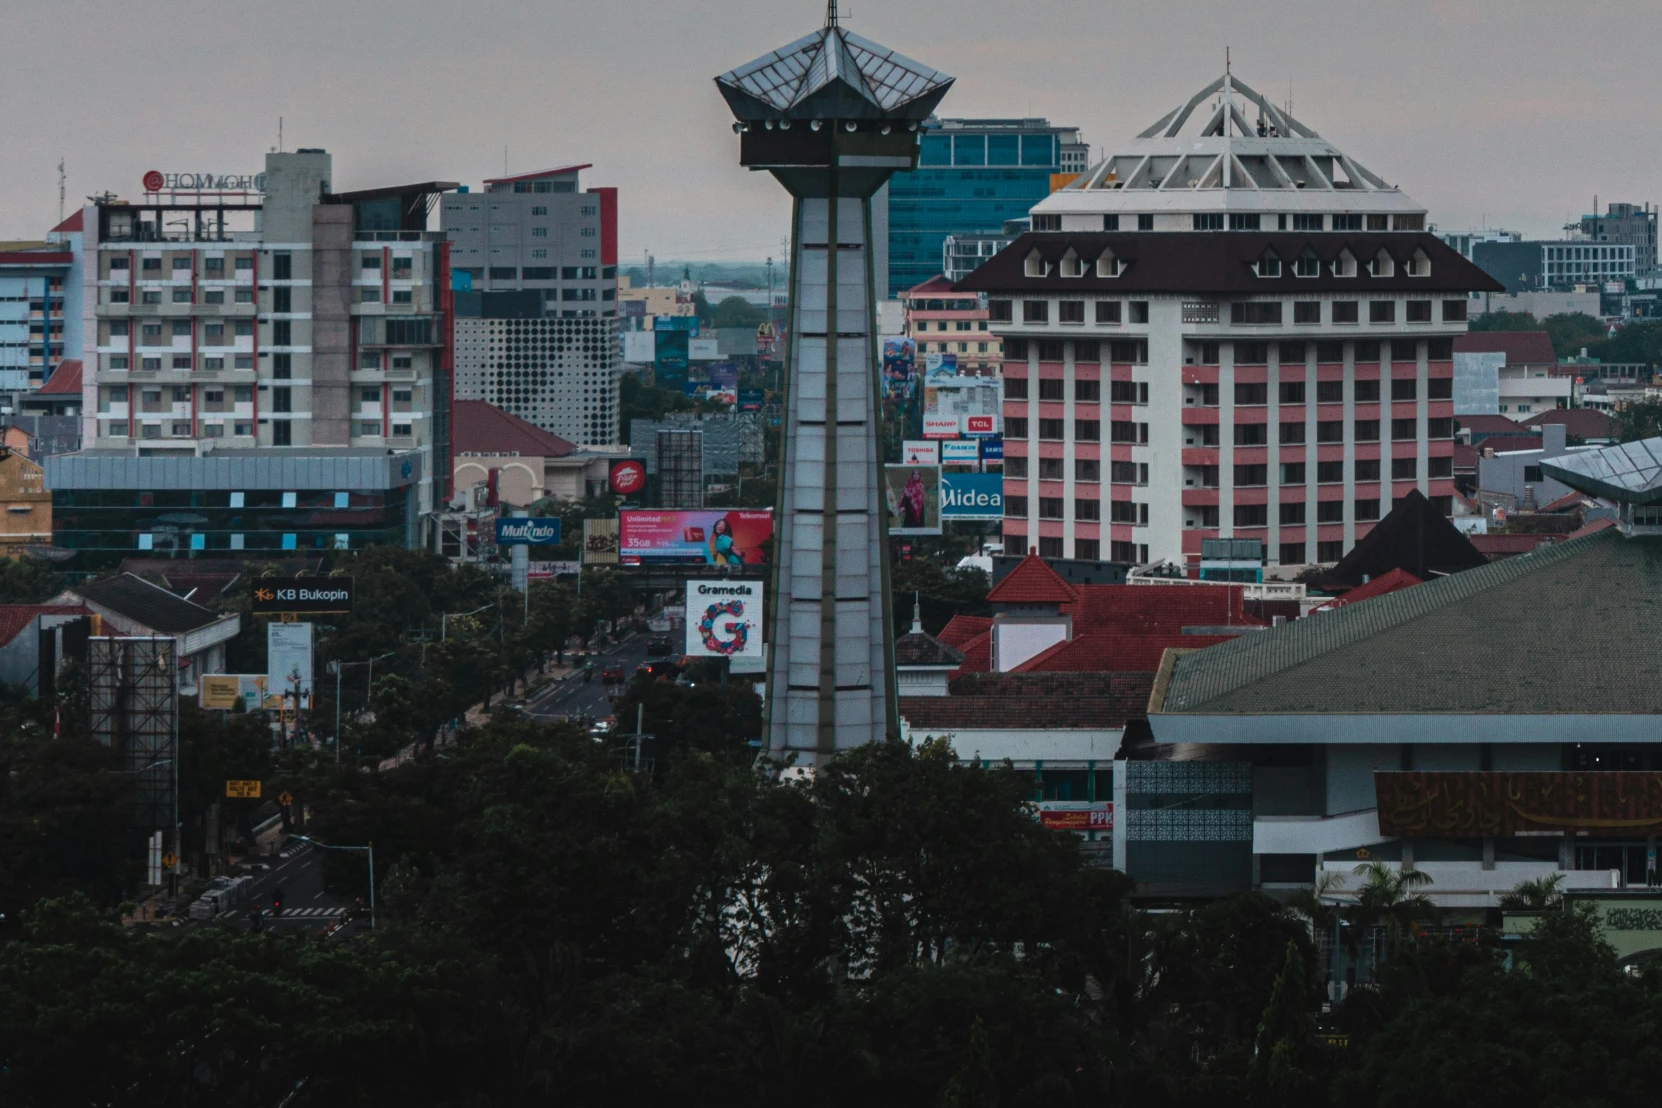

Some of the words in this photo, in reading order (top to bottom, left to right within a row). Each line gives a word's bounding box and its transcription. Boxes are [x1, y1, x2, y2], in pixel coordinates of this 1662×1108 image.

[972, 420, 989, 428] TCL
[616, 474, 638, 484] Pizza
[942, 489, 1001, 508] Midea
[501, 520, 554, 541] Multindo
[277, 589, 296, 600] KB
[300, 589, 348, 601] Bukopin
[698, 585, 752, 595] Gramedia
[698, 600, 747, 654] G
